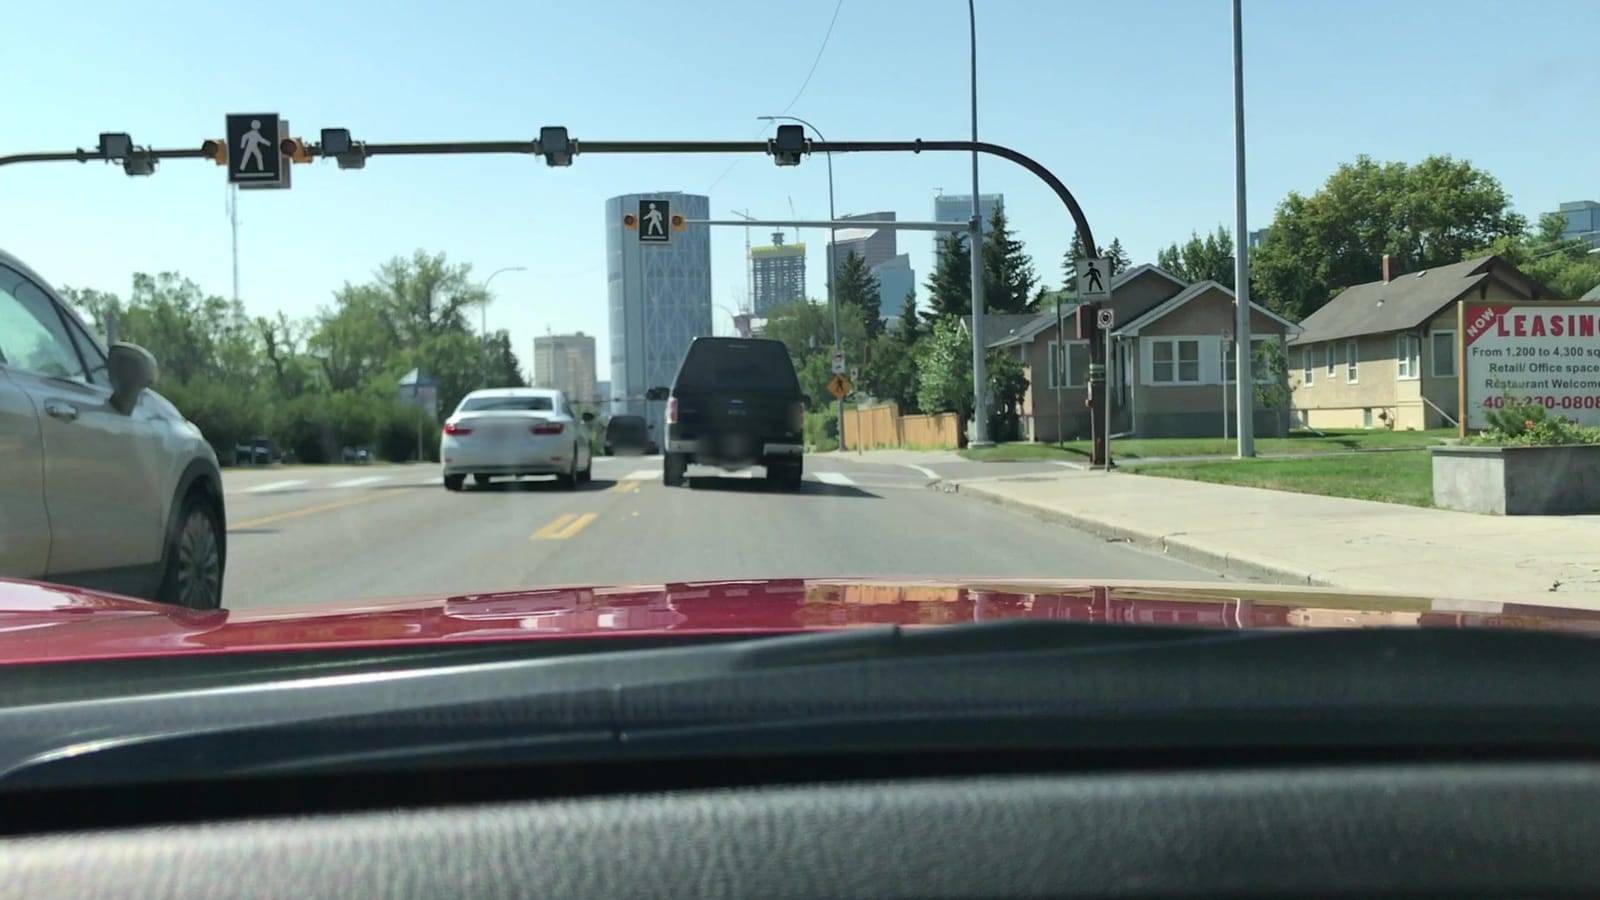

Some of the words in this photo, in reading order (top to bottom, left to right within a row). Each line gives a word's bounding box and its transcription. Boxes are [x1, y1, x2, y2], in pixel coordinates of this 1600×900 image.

[1467, 307, 1495, 337] NOW
[1497, 315, 1600, 337] LEASIN
[1472, 347, 1503, 357] From
[1506, 347, 1536, 358] 1,200
[1539, 347, 1550, 357] to
[1553, 347, 1584, 358] 4,300
[1489, 363, 1526, 373] Retail/
[1529, 363, 1562, 373] Office
[1485, 379, 1549, 389] Restaurant
